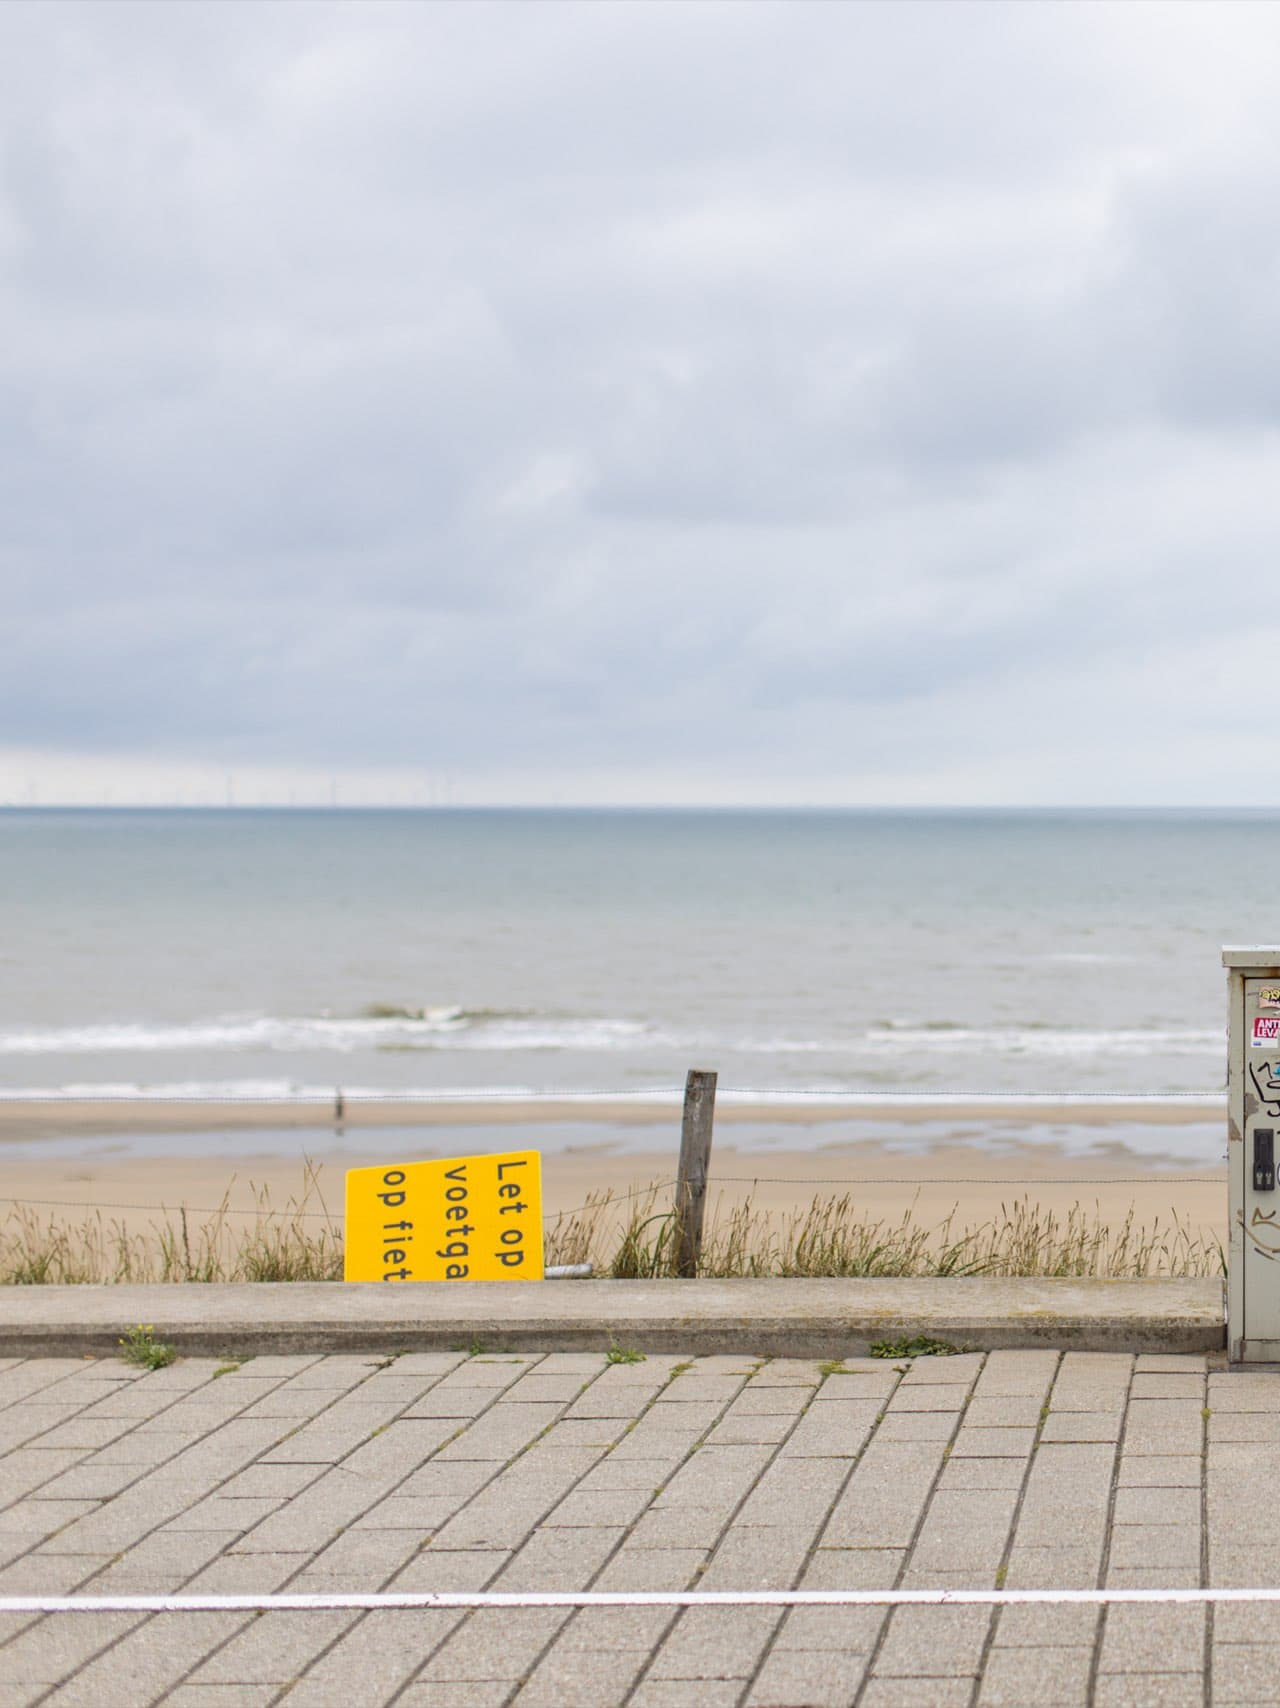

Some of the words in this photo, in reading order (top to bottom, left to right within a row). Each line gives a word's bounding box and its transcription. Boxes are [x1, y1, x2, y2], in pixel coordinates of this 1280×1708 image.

[1258, 1019, 1280, 1028] ANTI
[377, 1170, 406, 1207] op
[497, 1160, 529, 1216] Let
[436, 1165, 475, 1280] voetga
[495, 1228, 525, 1267] op
